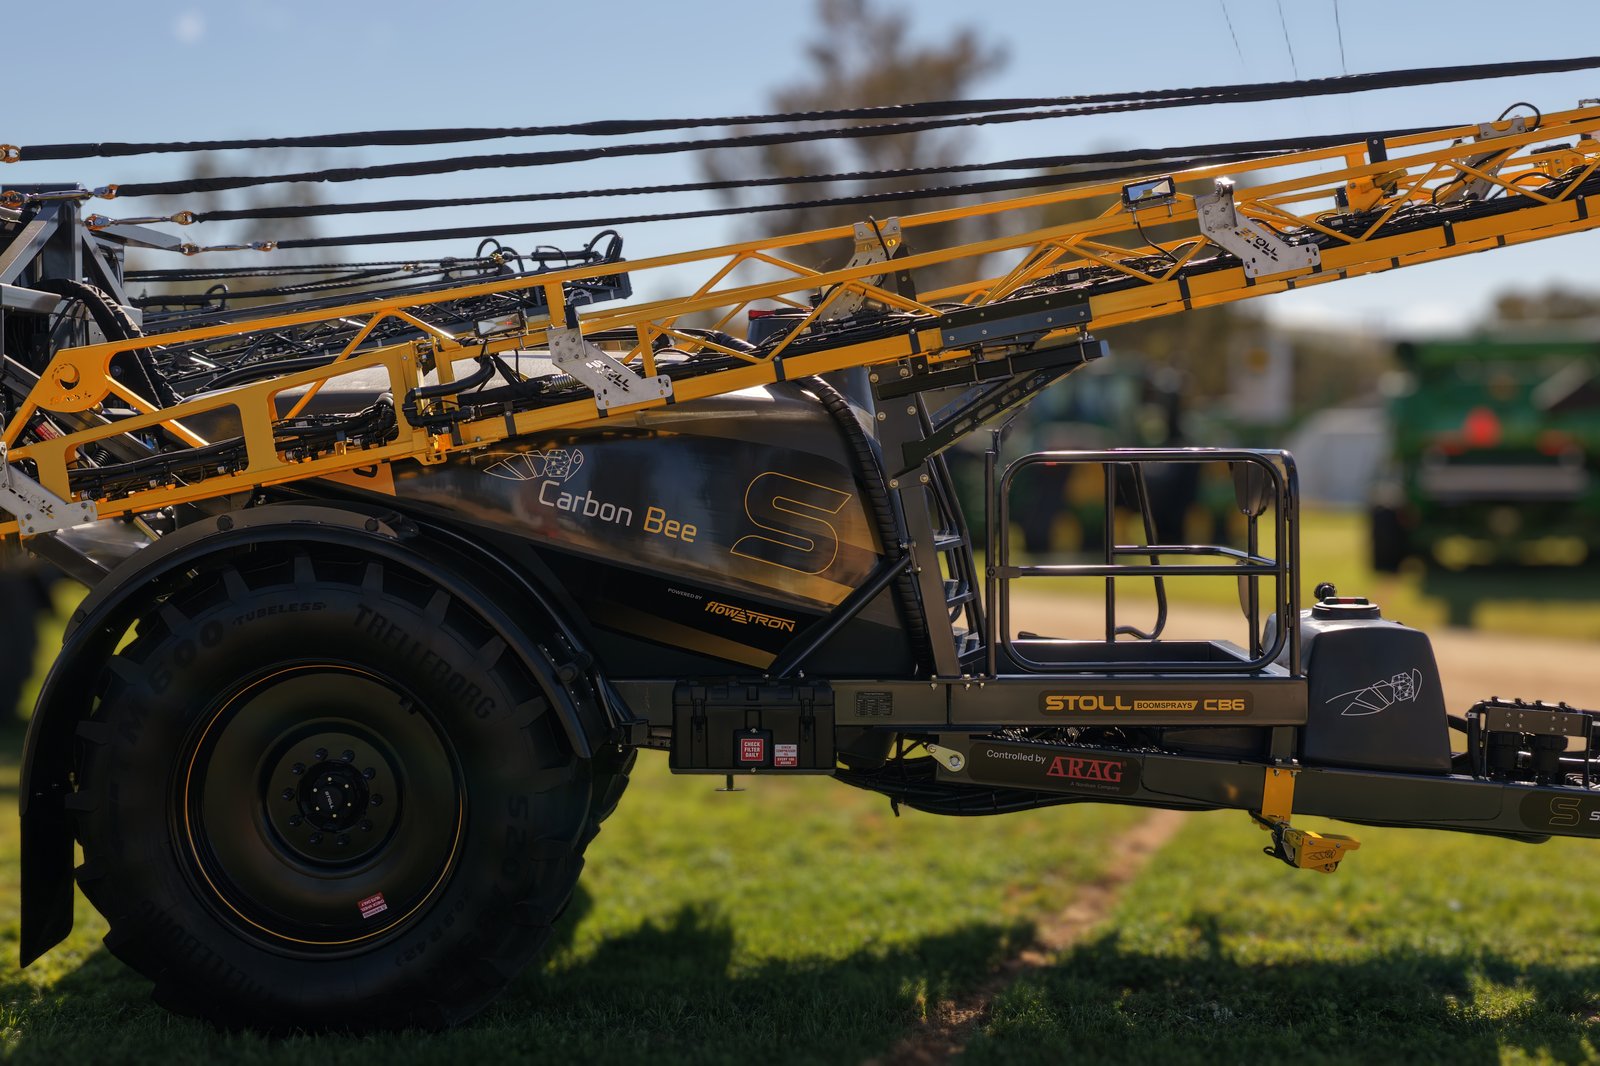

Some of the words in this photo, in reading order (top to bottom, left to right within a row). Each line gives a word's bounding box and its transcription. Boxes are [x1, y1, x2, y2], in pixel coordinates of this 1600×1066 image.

[538, 480, 633, 527] Carbon
[643, 505, 698, 543] Bee
[667, 587, 695, 600] POWERED
[236, 602, 325, 625] TUBELESS
[147, 619, 224, 696] 600
[353, 603, 497, 720] TRELLEBORG
[1045, 695, 1132, 711] STOLL
[1136, 702, 1193, 710] BOOMSPRAYS
[1203, 698, 1245, 711] CB6
[986, 749, 1034, 762] Controlled
[1035, 754, 1047, 765] by
[1046, 755, 1121, 782] ARAG
